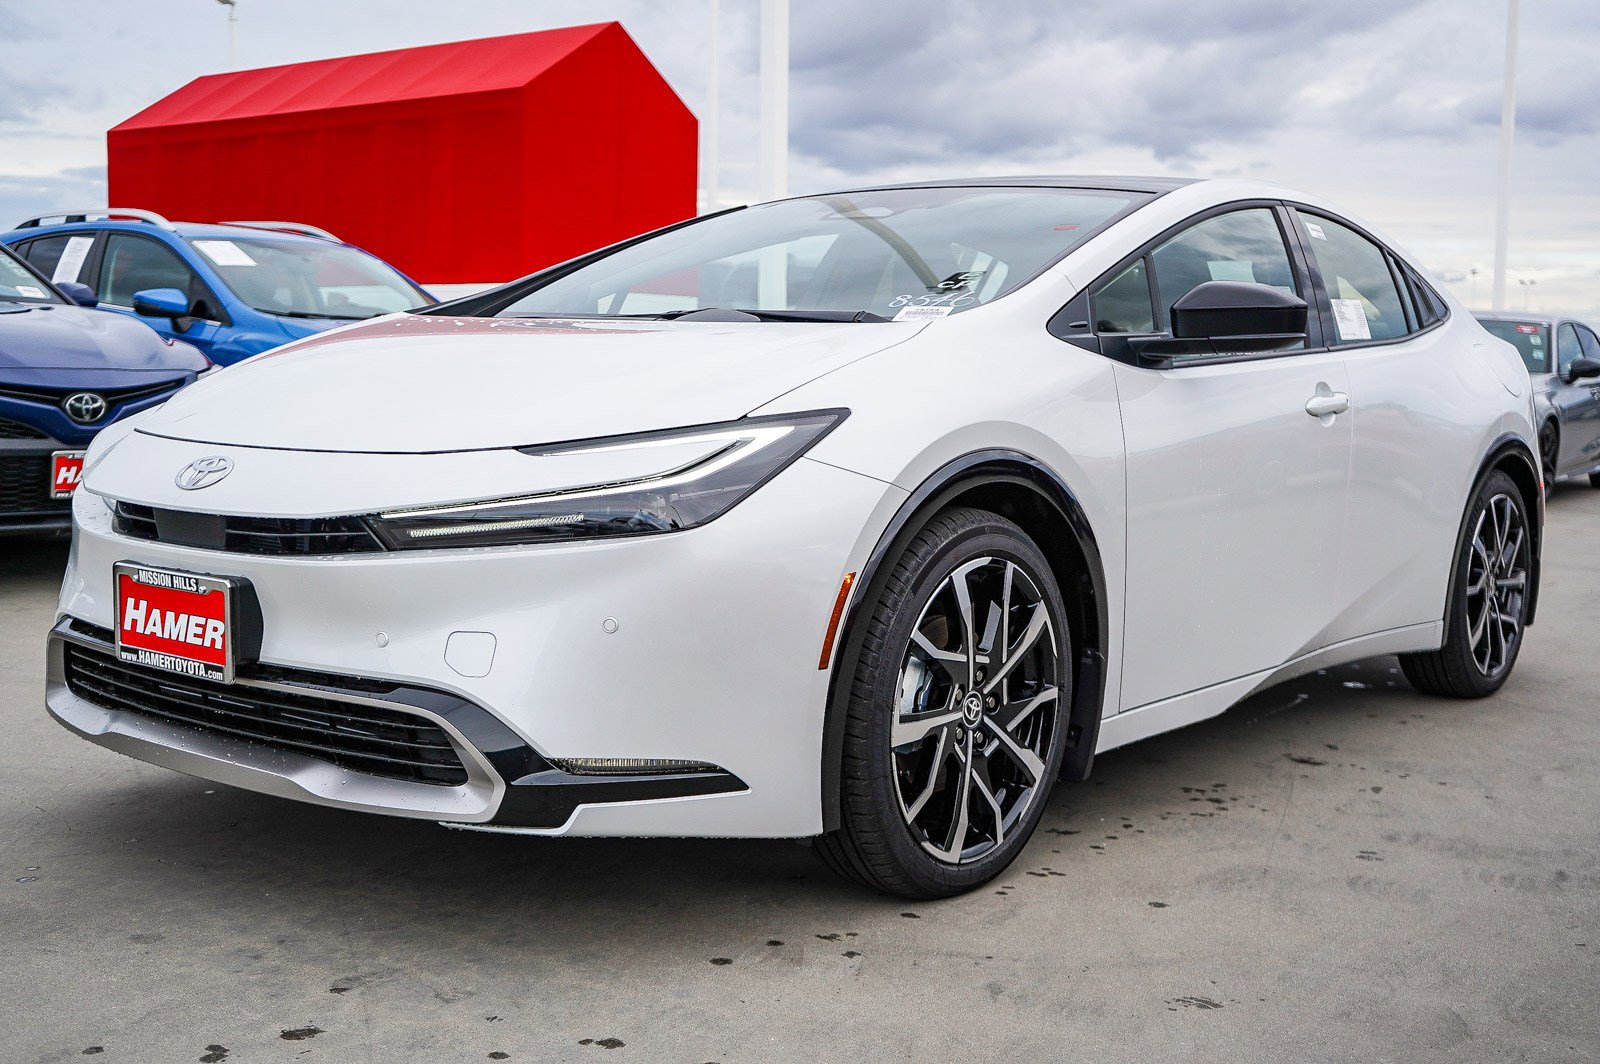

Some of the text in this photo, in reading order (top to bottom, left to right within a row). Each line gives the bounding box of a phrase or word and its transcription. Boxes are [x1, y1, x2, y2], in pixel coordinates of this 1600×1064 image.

[138, 569, 197, 592] MISSION HILLS
[123, 597, 225, 650] HAMER
[120, 650, 223, 681] www.HAMERTOYOTA.com
